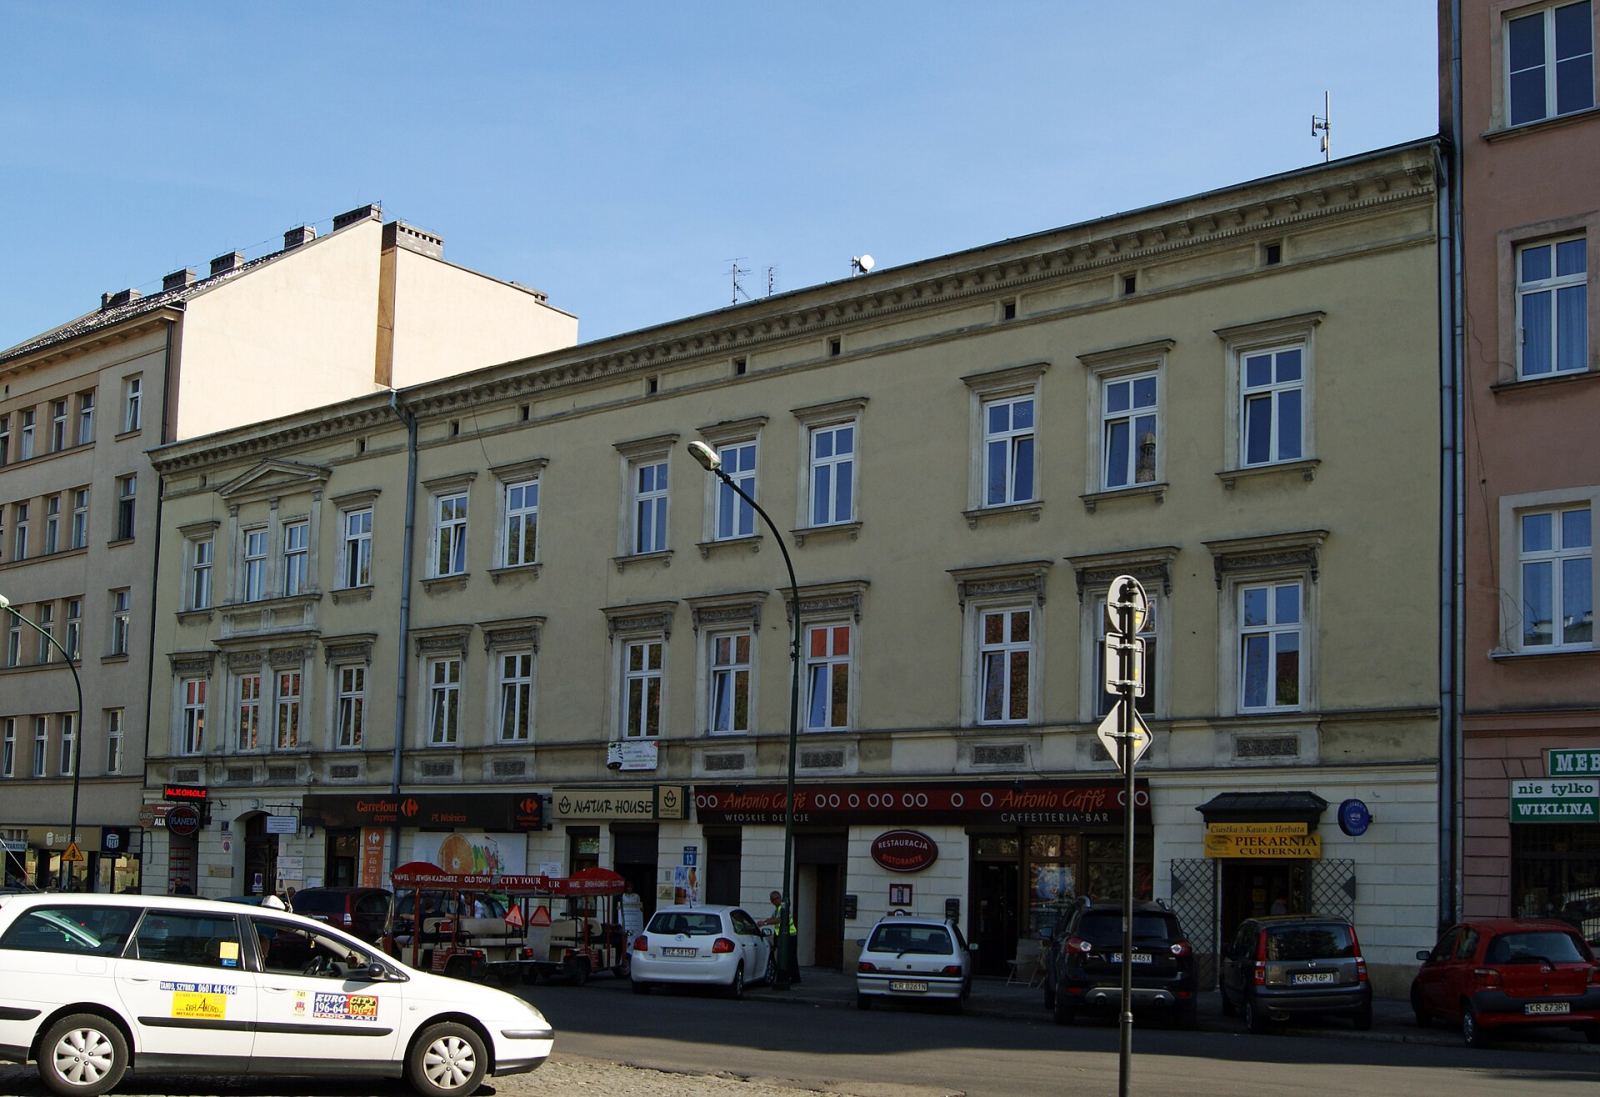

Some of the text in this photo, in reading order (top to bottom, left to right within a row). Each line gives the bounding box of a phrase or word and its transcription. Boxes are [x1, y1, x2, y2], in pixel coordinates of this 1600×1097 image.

[1518, 782, 1593, 797] nie tylko
[356, 799, 398, 813] Carrefour
[574, 799, 613, 814] NATUR
[615, 799, 655, 814] HOUSE
[722, 792, 770, 809] Antonio
[1000, 790, 1106, 813] Antonio Caffé
[1517, 803, 1594, 816] WIKLINA
[878, 840, 928, 850] RESTAURACJA
[1235, 836, 1318, 847] PIEKARNIA
[1239, 848, 1311, 856] CUKIERNIA
[464, 876, 475, 884] OLD
[476, 877, 491, 885] TOWN
[500, 876, 519, 885] CITY
[520, 876, 541, 885] TOUR
[315, 1002, 345, 1013] 196-64
